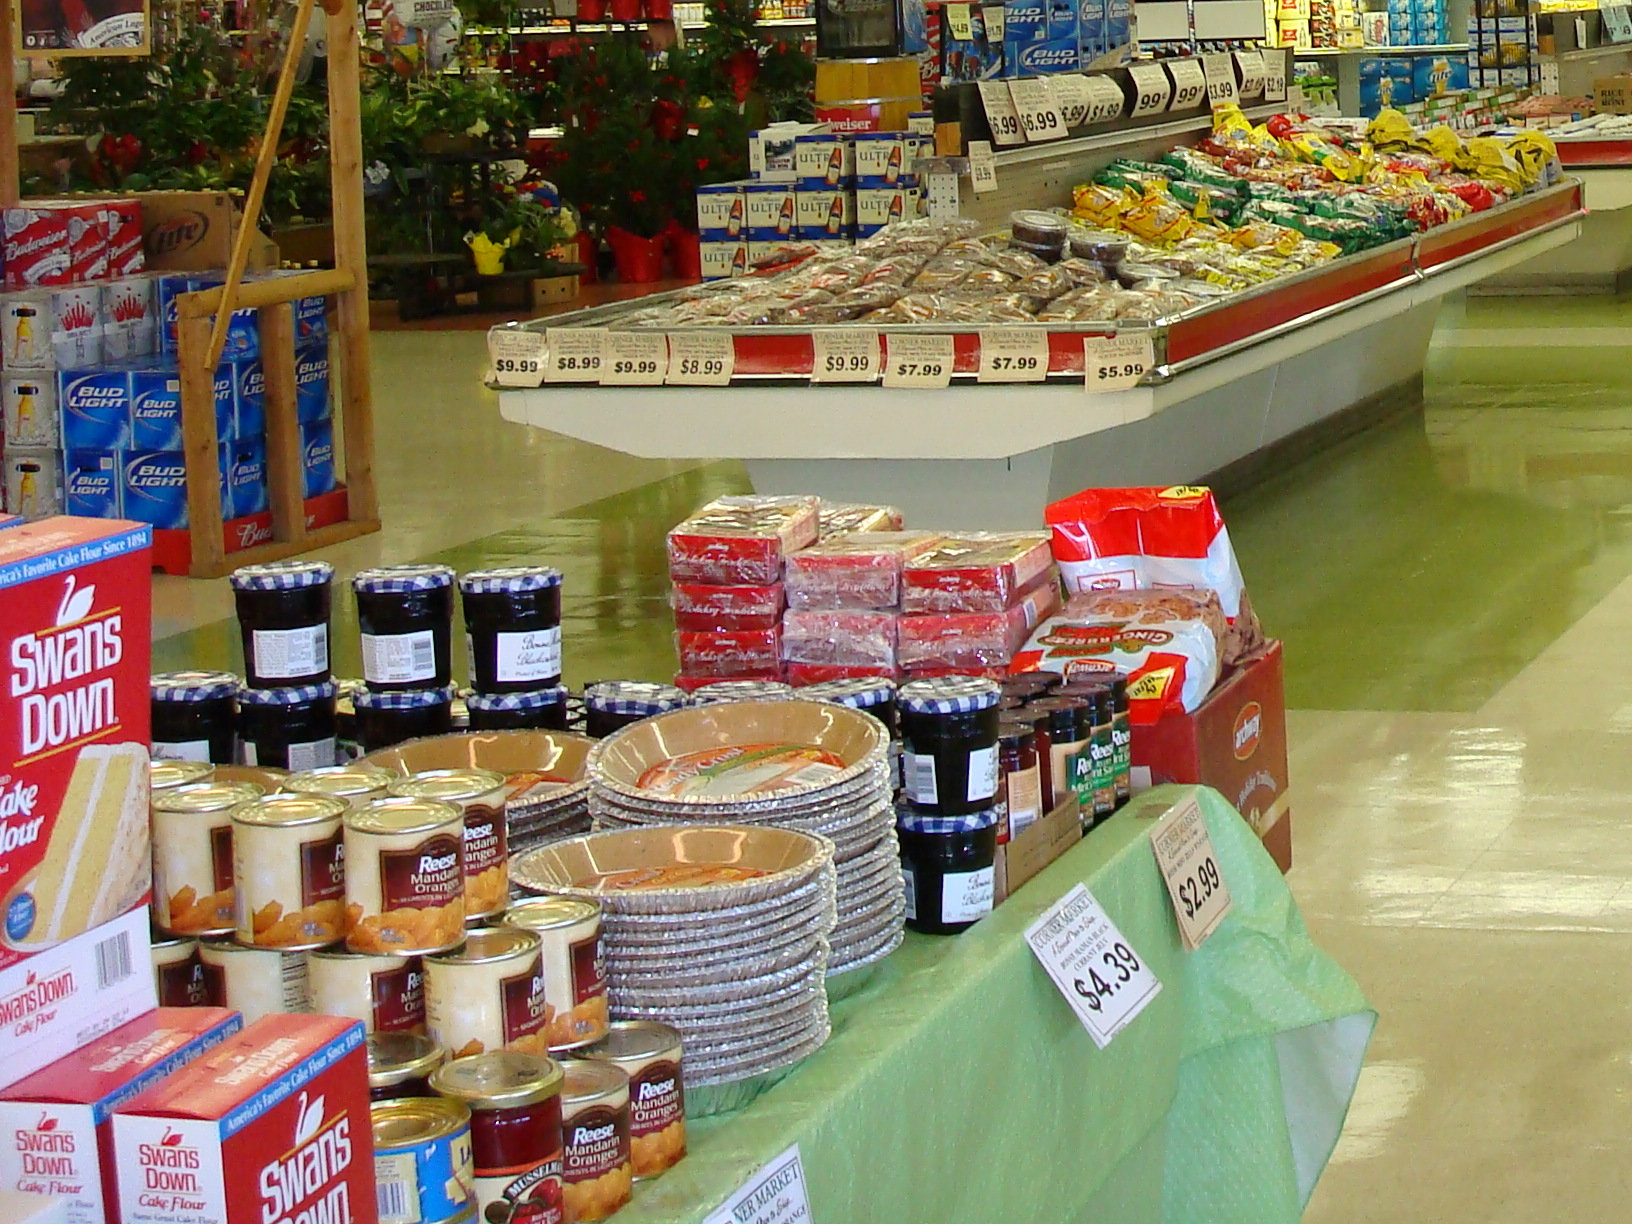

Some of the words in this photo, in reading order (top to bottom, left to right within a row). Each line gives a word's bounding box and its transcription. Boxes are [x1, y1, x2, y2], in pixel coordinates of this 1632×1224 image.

[1023, 56, 1080, 67] LIGHT
[1033, 49, 1076, 58] BUD
[1020, 110, 1057, 132] $6.99
[5, 229, 68, 261] Budweiser
[496, 359, 538, 373] $9.99
[557, 356, 600, 371] $8.99
[614, 360, 656, 374] $9.99
[680, 359, 723, 375] $8.99
[825, 355, 869, 372] $9.99
[898, 363, 942, 377] $7.99
[991, 357, 1037, 371] $7.99
[1098, 363, 1144, 380] $5.99
[77, 386, 124, 398] BUD
[70, 396, 128, 408] LIGHT
[142, 399, 176, 409] BUD
[135, 409, 177, 418] LIGHT
[310, 444, 331, 456] BUD
[307, 452, 331, 467] LIGHT
[138, 465, 186, 476] BUD
[234, 470, 262, 485] LIGHT
[238, 463, 260, 475] BUD
[77, 476, 109, 485] BUD
[130, 476, 186, 487] LIGHT
[69, 485, 110, 495] LIGHT
[23, 557, 57, 579] Favorite
[58, 551, 79, 570] Cake
[80, 545, 102, 564] Flour
[103, 539, 125, 557] Since
[126, 531, 147, 550] 1894
[11, 614, 123, 697] Swans
[418, 852, 457, 873] Reese
[1178, 857, 1220, 919] $2.99
[1060, 893, 1094, 927] MARKET
[1074, 942, 1141, 1014] $4.39
[227, 1100, 261, 1131] America's
[262, 1083, 290, 1113] Favorite
[291, 1074, 309, 1095] Cake
[309, 1061, 326, 1082] Flour
[326, 1045, 345, 1067] Since
[345, 1030, 363, 1053] 1894
[638, 1078, 675, 1100] Reese
[631, 1090, 680, 1112] Mandarin
[635, 1103, 678, 1122] Oranges
[15, 1131, 76, 1153] Swans
[573, 1124, 615, 1145] Reese
[565, 1135, 621, 1158] Mandarin
[139, 1144, 200, 1169] Swans
[569, 1148, 618, 1168] Oranges
[260, 1115, 352, 1224] Swans
[16, 1179, 46, 1194] Cake
[49, 1179, 84, 1195] Flour
[754, 1163, 799, 1210] MARKET
[137, 1194, 170, 1211] Cake
[171, 1194, 207, 1211] Flour
